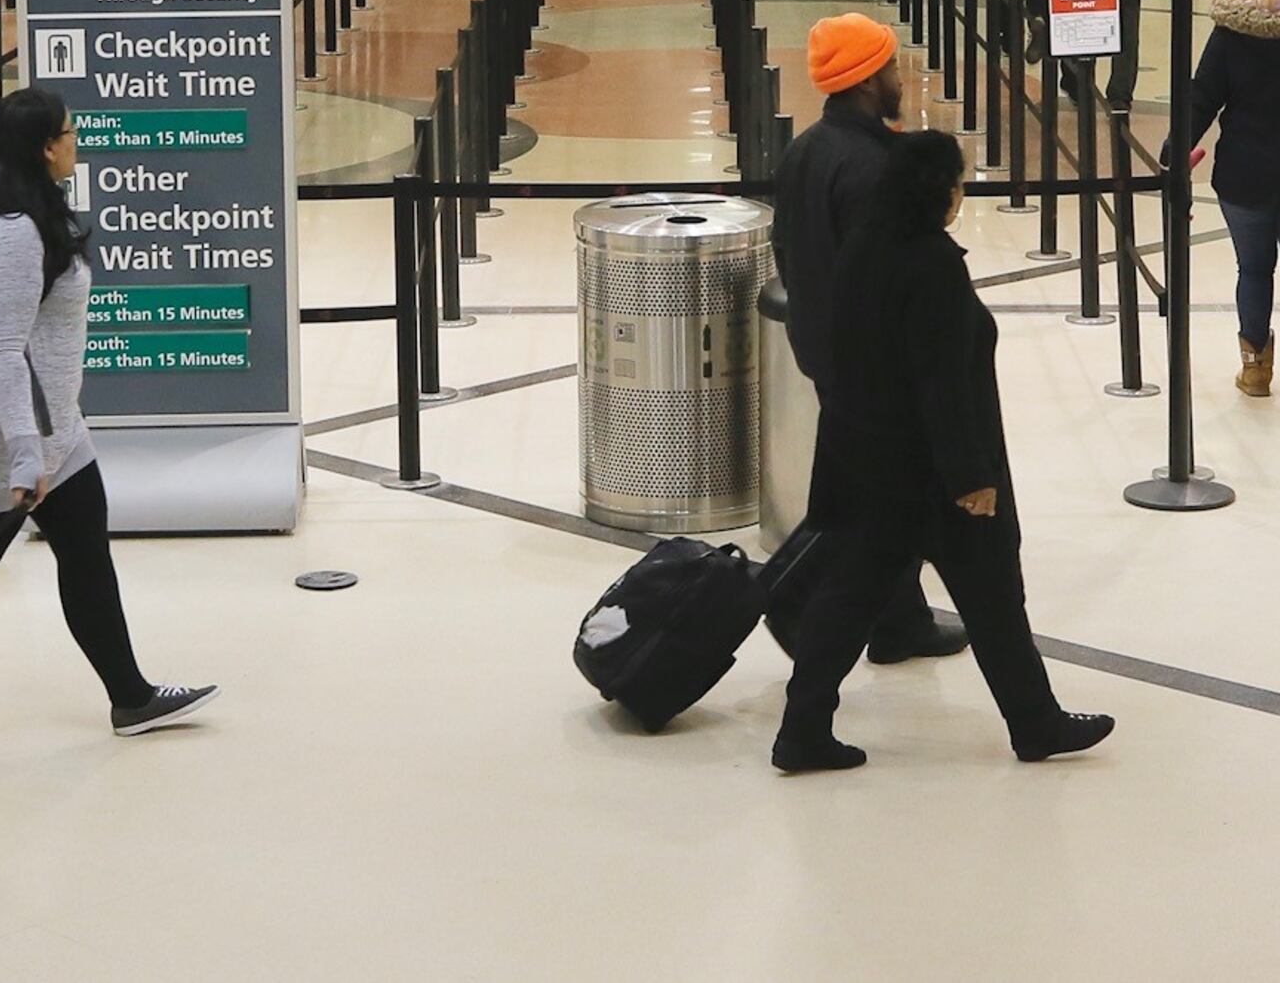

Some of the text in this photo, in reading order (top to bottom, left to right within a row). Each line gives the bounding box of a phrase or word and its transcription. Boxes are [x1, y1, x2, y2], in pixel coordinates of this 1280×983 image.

[1072, 1, 1096, 9] POINT
[95, 30, 271, 63] Checkpoint
[95, 71, 255, 98] Wait Time
[76, 115, 121, 129] Main:
[114, 132, 150, 146] than
[156, 132, 174, 145] 15
[179, 130, 244, 145] Minutes
[99, 165, 188, 192] Other
[99, 204, 274, 236] Checkpoint
[99, 243, 274, 270] Wait Times
[87, 291, 128, 305] orth:
[86, 307, 244, 322] ess than 15 Minutes
[84, 336, 129, 350] outh:
[116, 354, 152, 367] than
[158, 353, 175, 367] 15
[180, 353, 244, 367] Minutes
